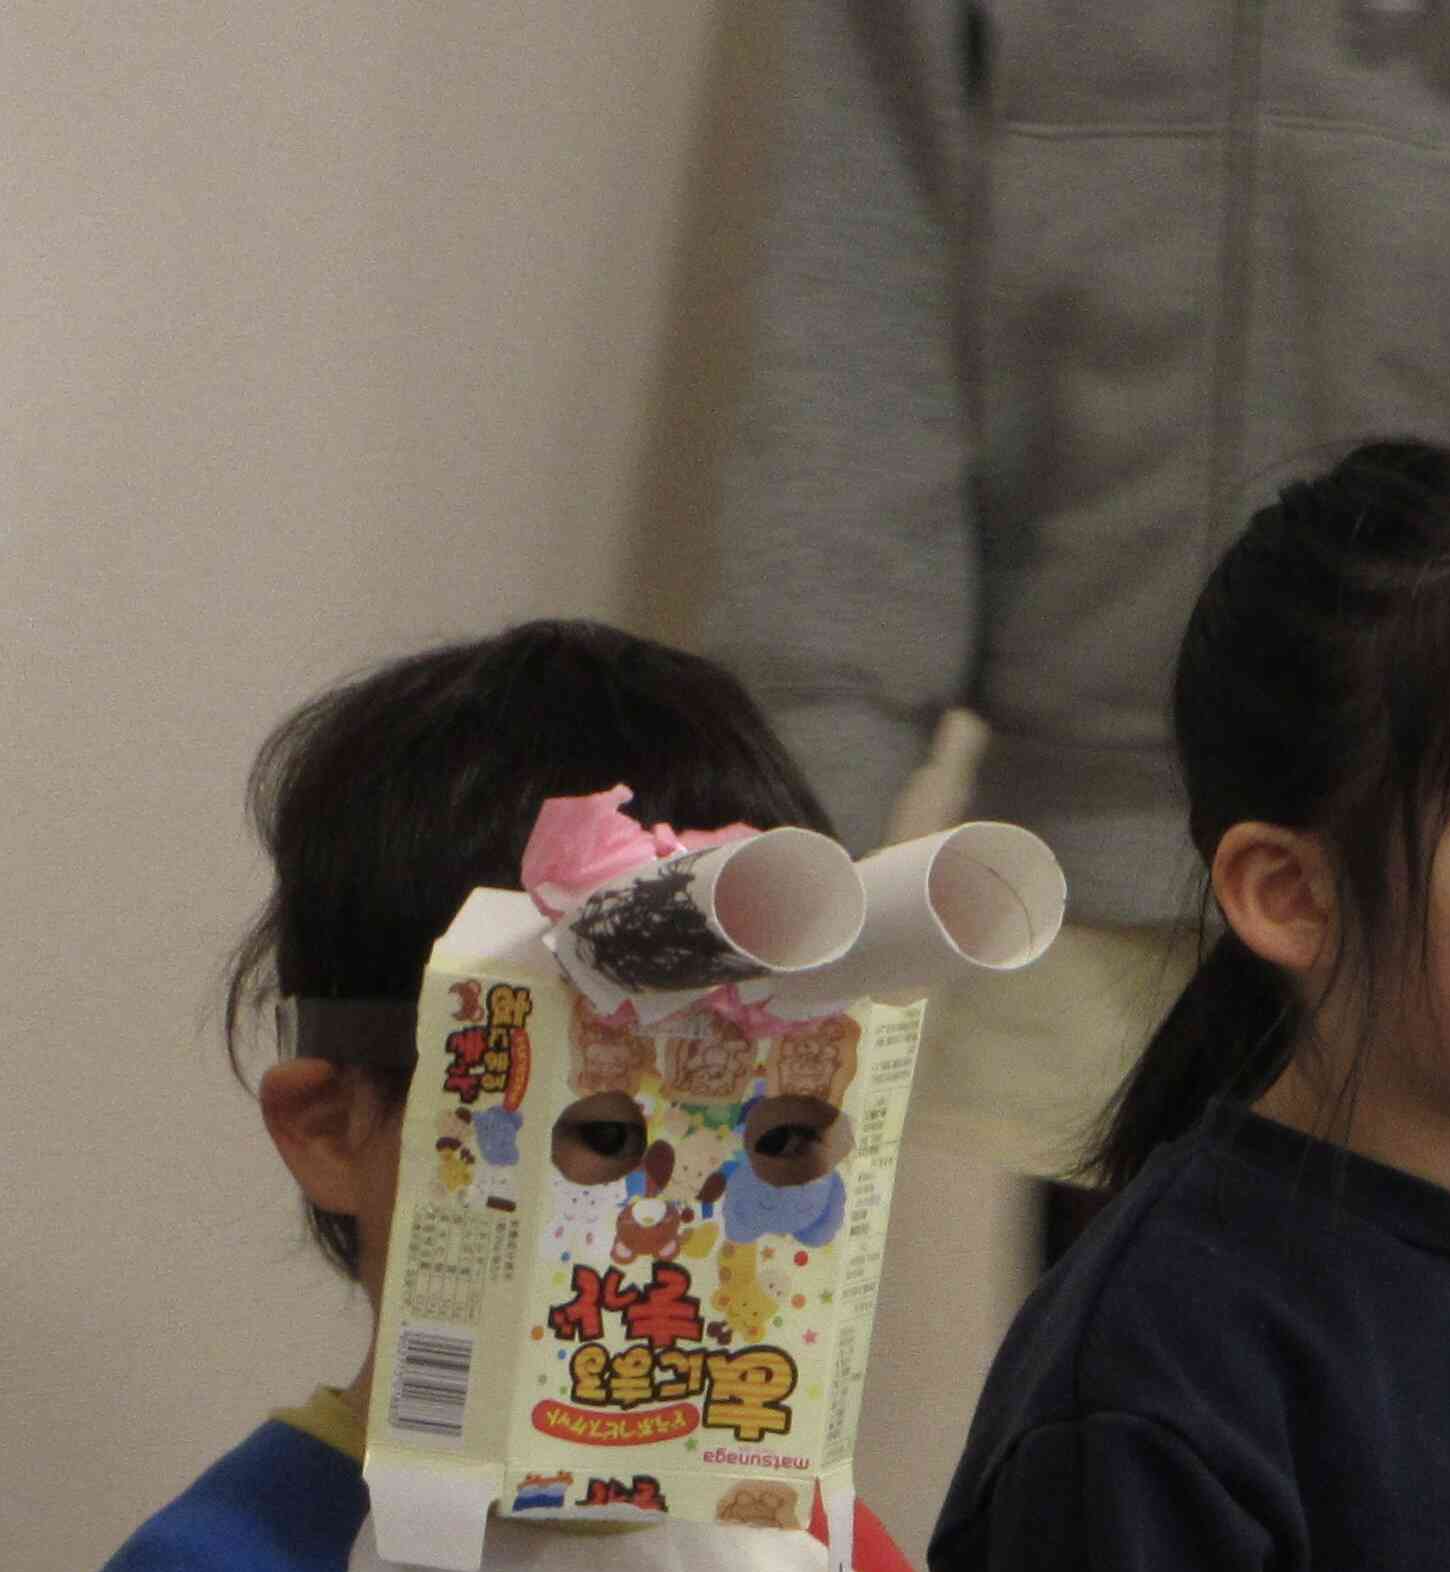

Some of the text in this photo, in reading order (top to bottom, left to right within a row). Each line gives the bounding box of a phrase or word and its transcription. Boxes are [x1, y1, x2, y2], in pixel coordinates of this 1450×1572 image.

[548, 1263, 704, 1350] きっど
[569, 1344, 798, 1443] あにまる
[703, 1448, 811, 1472] matsunaga
